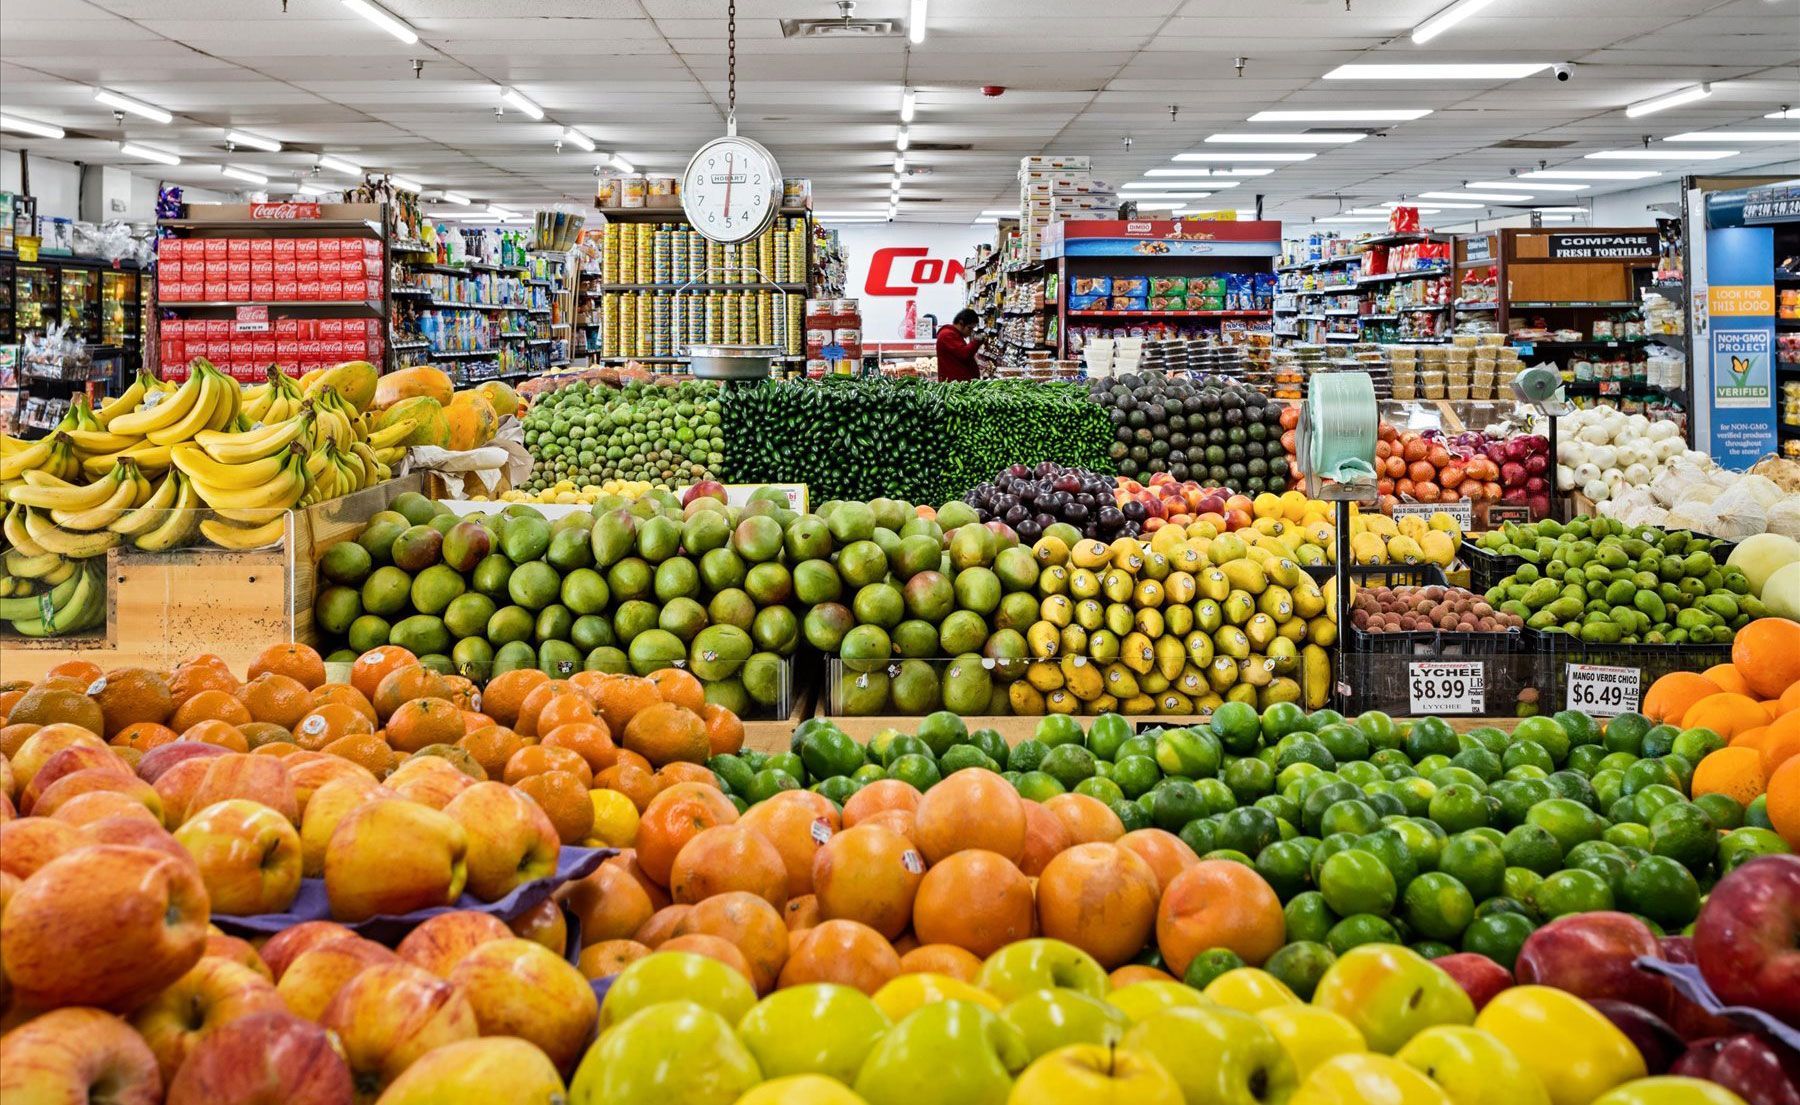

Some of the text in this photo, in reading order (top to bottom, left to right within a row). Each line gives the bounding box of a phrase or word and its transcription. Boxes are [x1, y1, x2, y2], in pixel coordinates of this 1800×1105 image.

[708, 159, 715, 169] 9
[743, 158, 748, 169] 1
[697, 175, 704, 186] 8
[753, 174, 761, 185] 2
[698, 196, 705, 206] 7
[753, 195, 761, 206] 3
[253, 204, 298, 219] Coca-Cola
[742, 211, 749, 221] 4
[708, 212, 715, 222] 6
[726, 218, 732, 228] 5
[1561, 236, 1647, 246] COMPARE
[1556, 247, 1652, 258] FRESH TORTILLAS
[1716, 290, 1762, 299] LOOK FOR
[1712, 301, 1770, 312] THIS LOGO
[1717, 334, 1766, 343] NON-GMO
[1718, 343, 1766, 352] PROJECT
[1718, 388, 1767, 397] VERIFIED
[1743, 432, 1771, 440] products
[1725, 440, 1762, 448] throughout
[1411, 669, 1481, 677] LYCHEE
[1573, 672, 1638, 684] MANGO VERDE CHICO
[1470, 678, 1484, 687] LB
[1413, 678, 1465, 701] $8.99
[1573, 682, 1622, 706] $6.49
